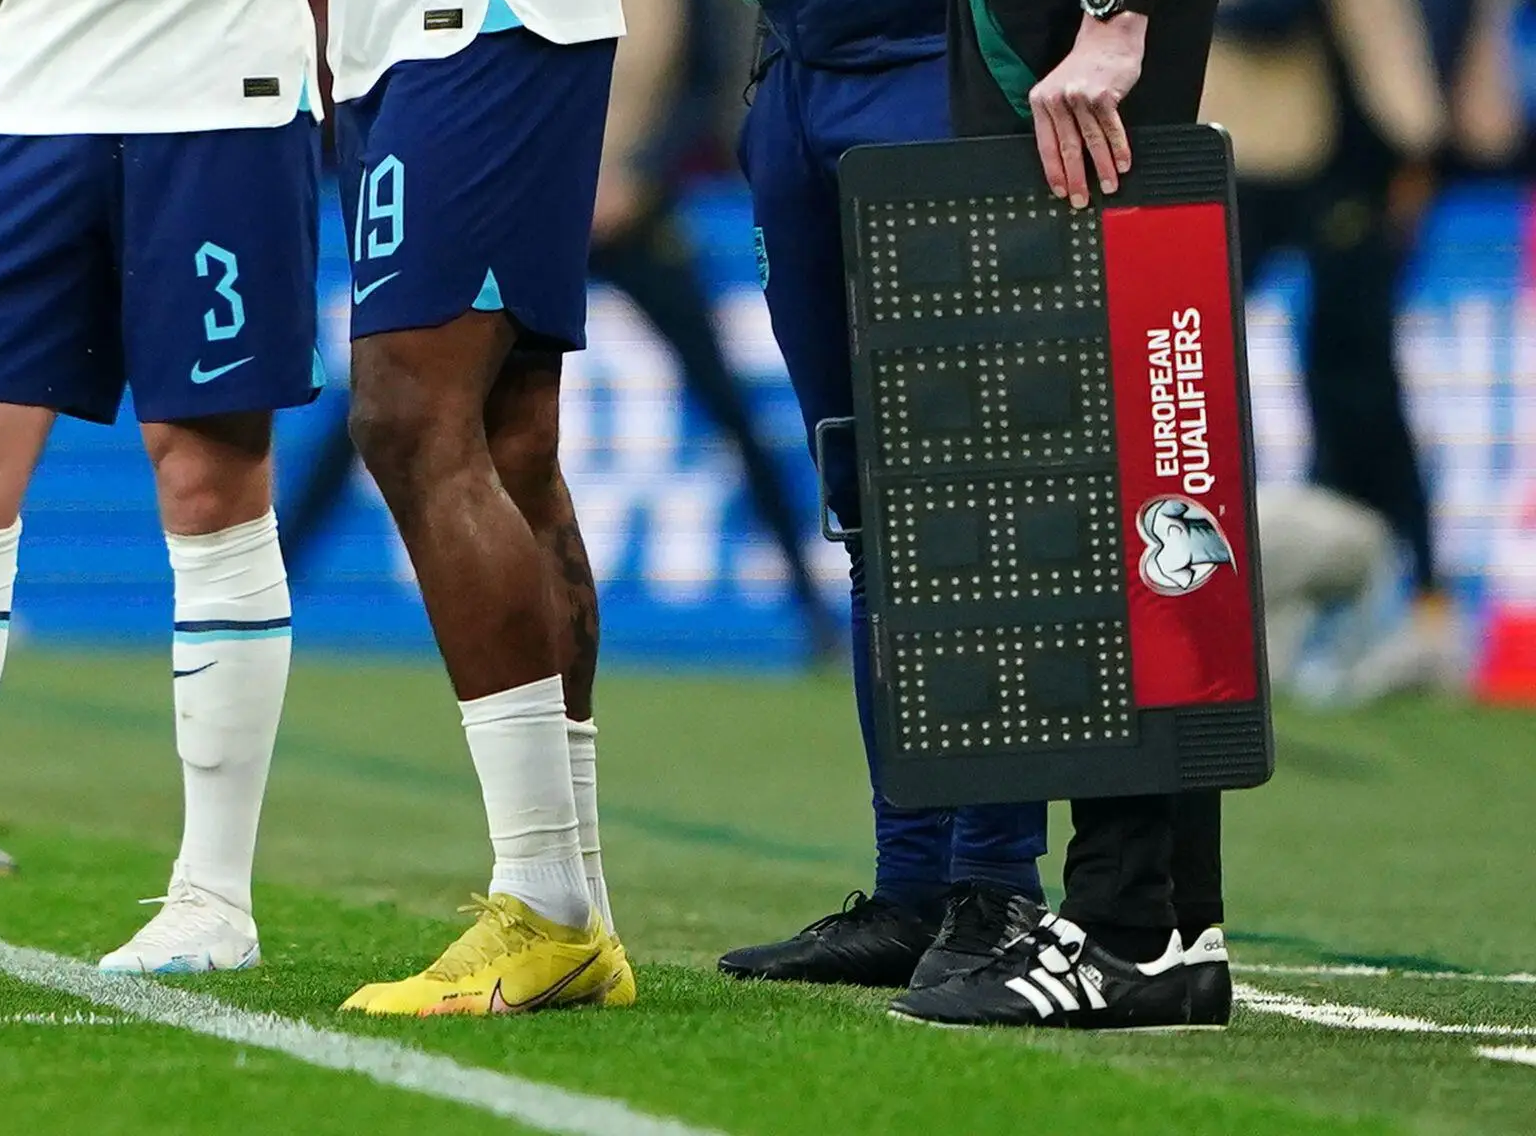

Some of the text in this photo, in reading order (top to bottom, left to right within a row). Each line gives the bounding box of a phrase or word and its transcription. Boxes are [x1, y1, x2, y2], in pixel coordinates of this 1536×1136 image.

[354, 153, 405, 262] 19
[195, 241, 245, 342] 3
[1146, 328, 1180, 478] EUROPEAN
[1172, 306, 1215, 495] QUALIFIERS
